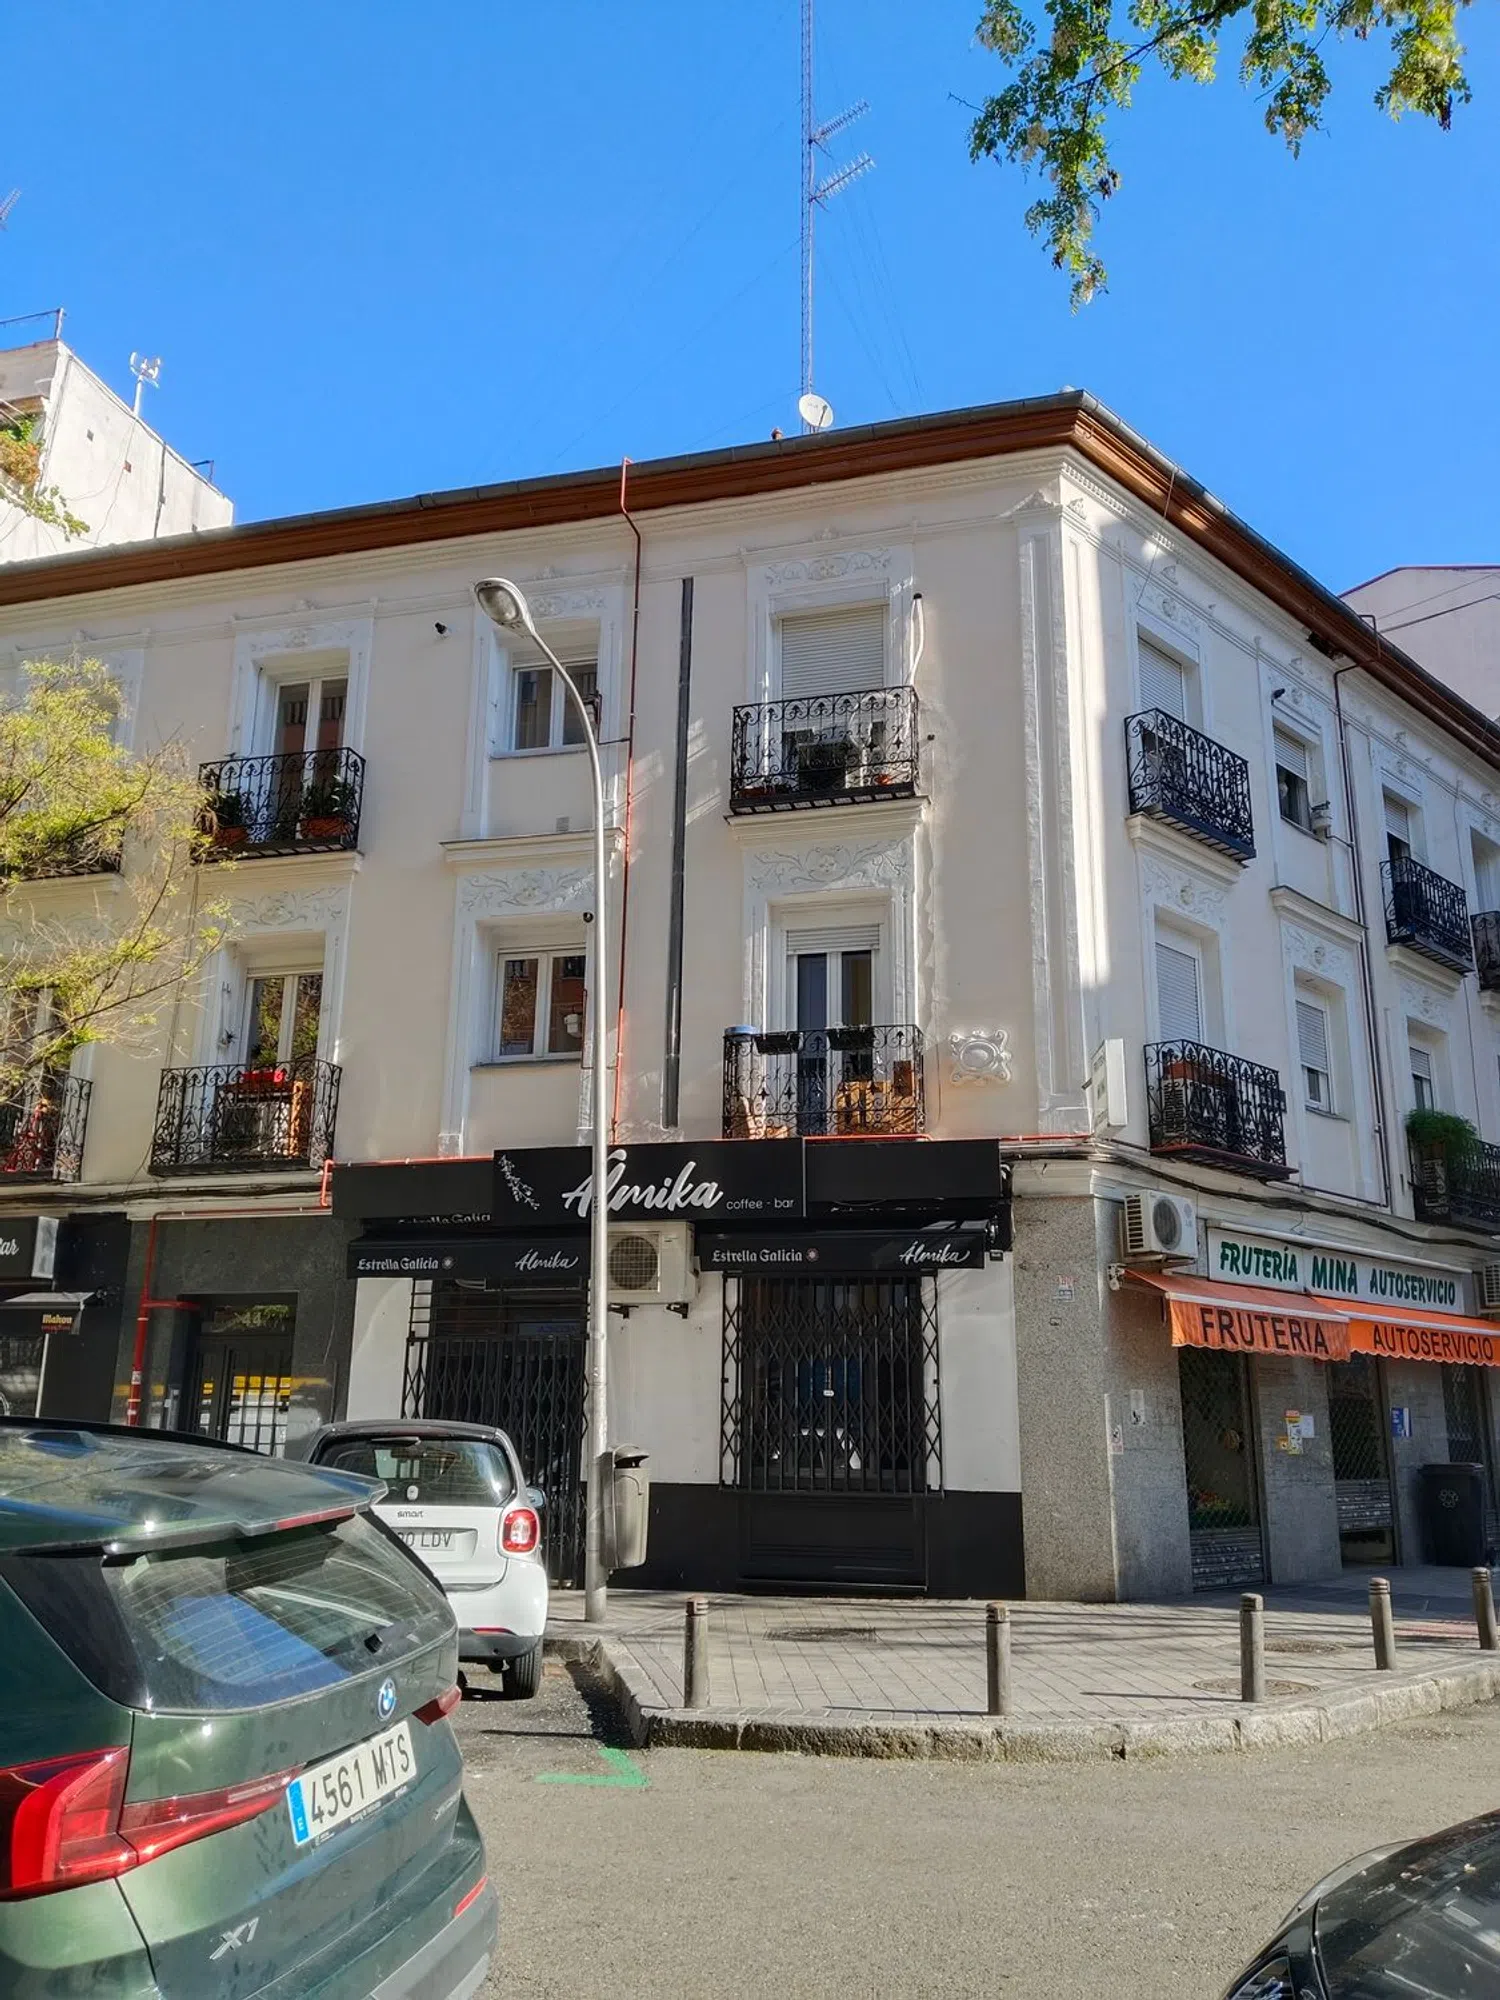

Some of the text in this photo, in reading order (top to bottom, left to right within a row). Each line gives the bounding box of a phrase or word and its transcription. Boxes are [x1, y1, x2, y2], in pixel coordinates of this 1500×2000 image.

[725, 1198, 763, 1210] coffee
[773, 1197, 794, 1209] bar
[357, 1257, 439, 1270] Estrella Galicia
[515, 1249, 579, 1270] Álmika
[712, 1248, 803, 1262] Estrella Galicia
[899, 1240, 971, 1266] Álmika
[1220, 1241, 1456, 1306] FRUTERÍA MINA AUTOSERVICIO
[1201, 1308, 1330, 1355] FRUTERIA
[1372, 1324, 1494, 1361] AUTOSERVICIO
[397, 1510, 424, 1519] smart
[421, 1531, 453, 1548] LDV
[311, 1758, 366, 1824] 4561
[371, 1733, 411, 1791] MTS
[209, 1916, 259, 1961] X1
